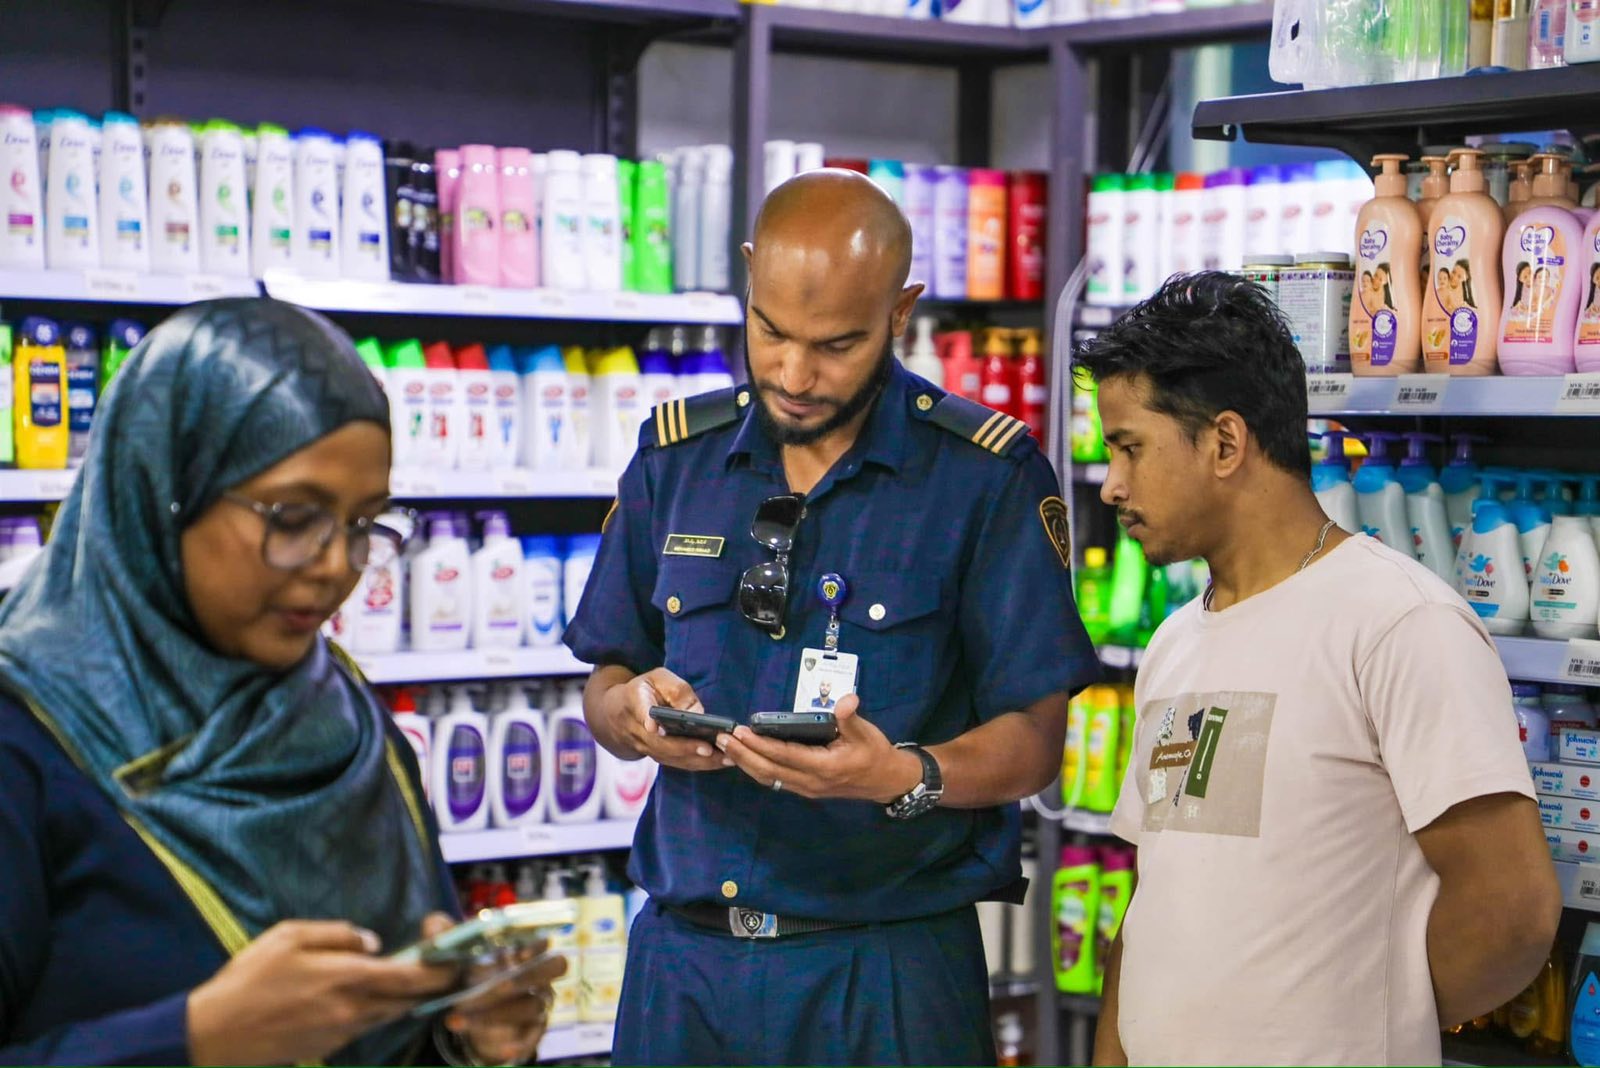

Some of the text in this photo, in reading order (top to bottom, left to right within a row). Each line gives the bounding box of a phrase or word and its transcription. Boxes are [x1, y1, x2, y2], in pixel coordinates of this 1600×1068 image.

[1476, 578, 1496, 588] Dove
[1552, 575, 1572, 585] Dove
[1566, 733, 1597, 747] Johnson's
[1532, 766, 1563, 780] Johnson's
